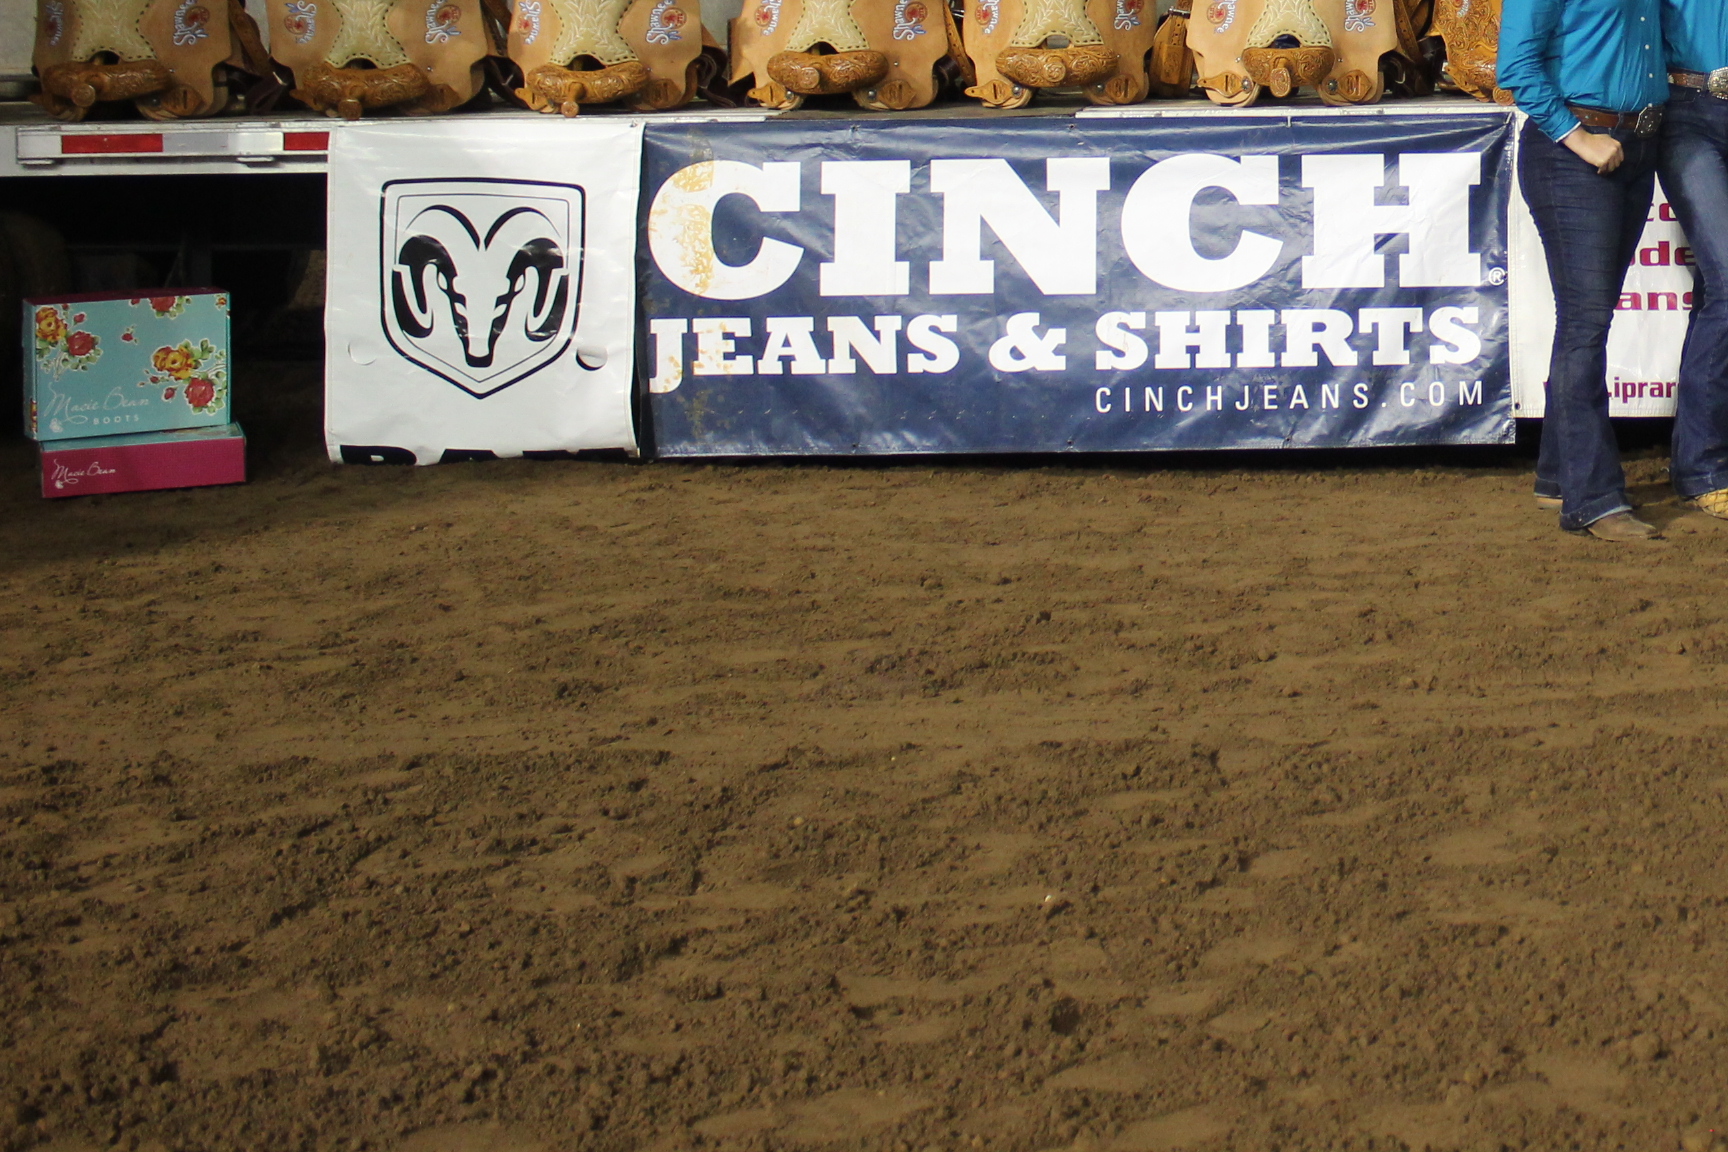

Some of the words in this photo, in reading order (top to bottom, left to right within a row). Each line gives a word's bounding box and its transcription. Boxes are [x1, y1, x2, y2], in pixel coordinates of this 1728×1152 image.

[173, 0, 198, 46] Shawnee
[646, 151, 1484, 301] CINCH
[1616, 289, 1694, 311] ans
[648, 315, 961, 395] JEANS
[988, 312, 1068, 373] &
[1095, 305, 1483, 371] SHIRTS
[44, 382, 98, 425] Macie
[103, 386, 150, 411] Bean
[1094, 379, 1485, 415] CINCHJEANS.COM
[93, 414, 140, 426] BOOTS
[51, 459, 85, 484] Macie
[86, 461, 117, 477] Bean
